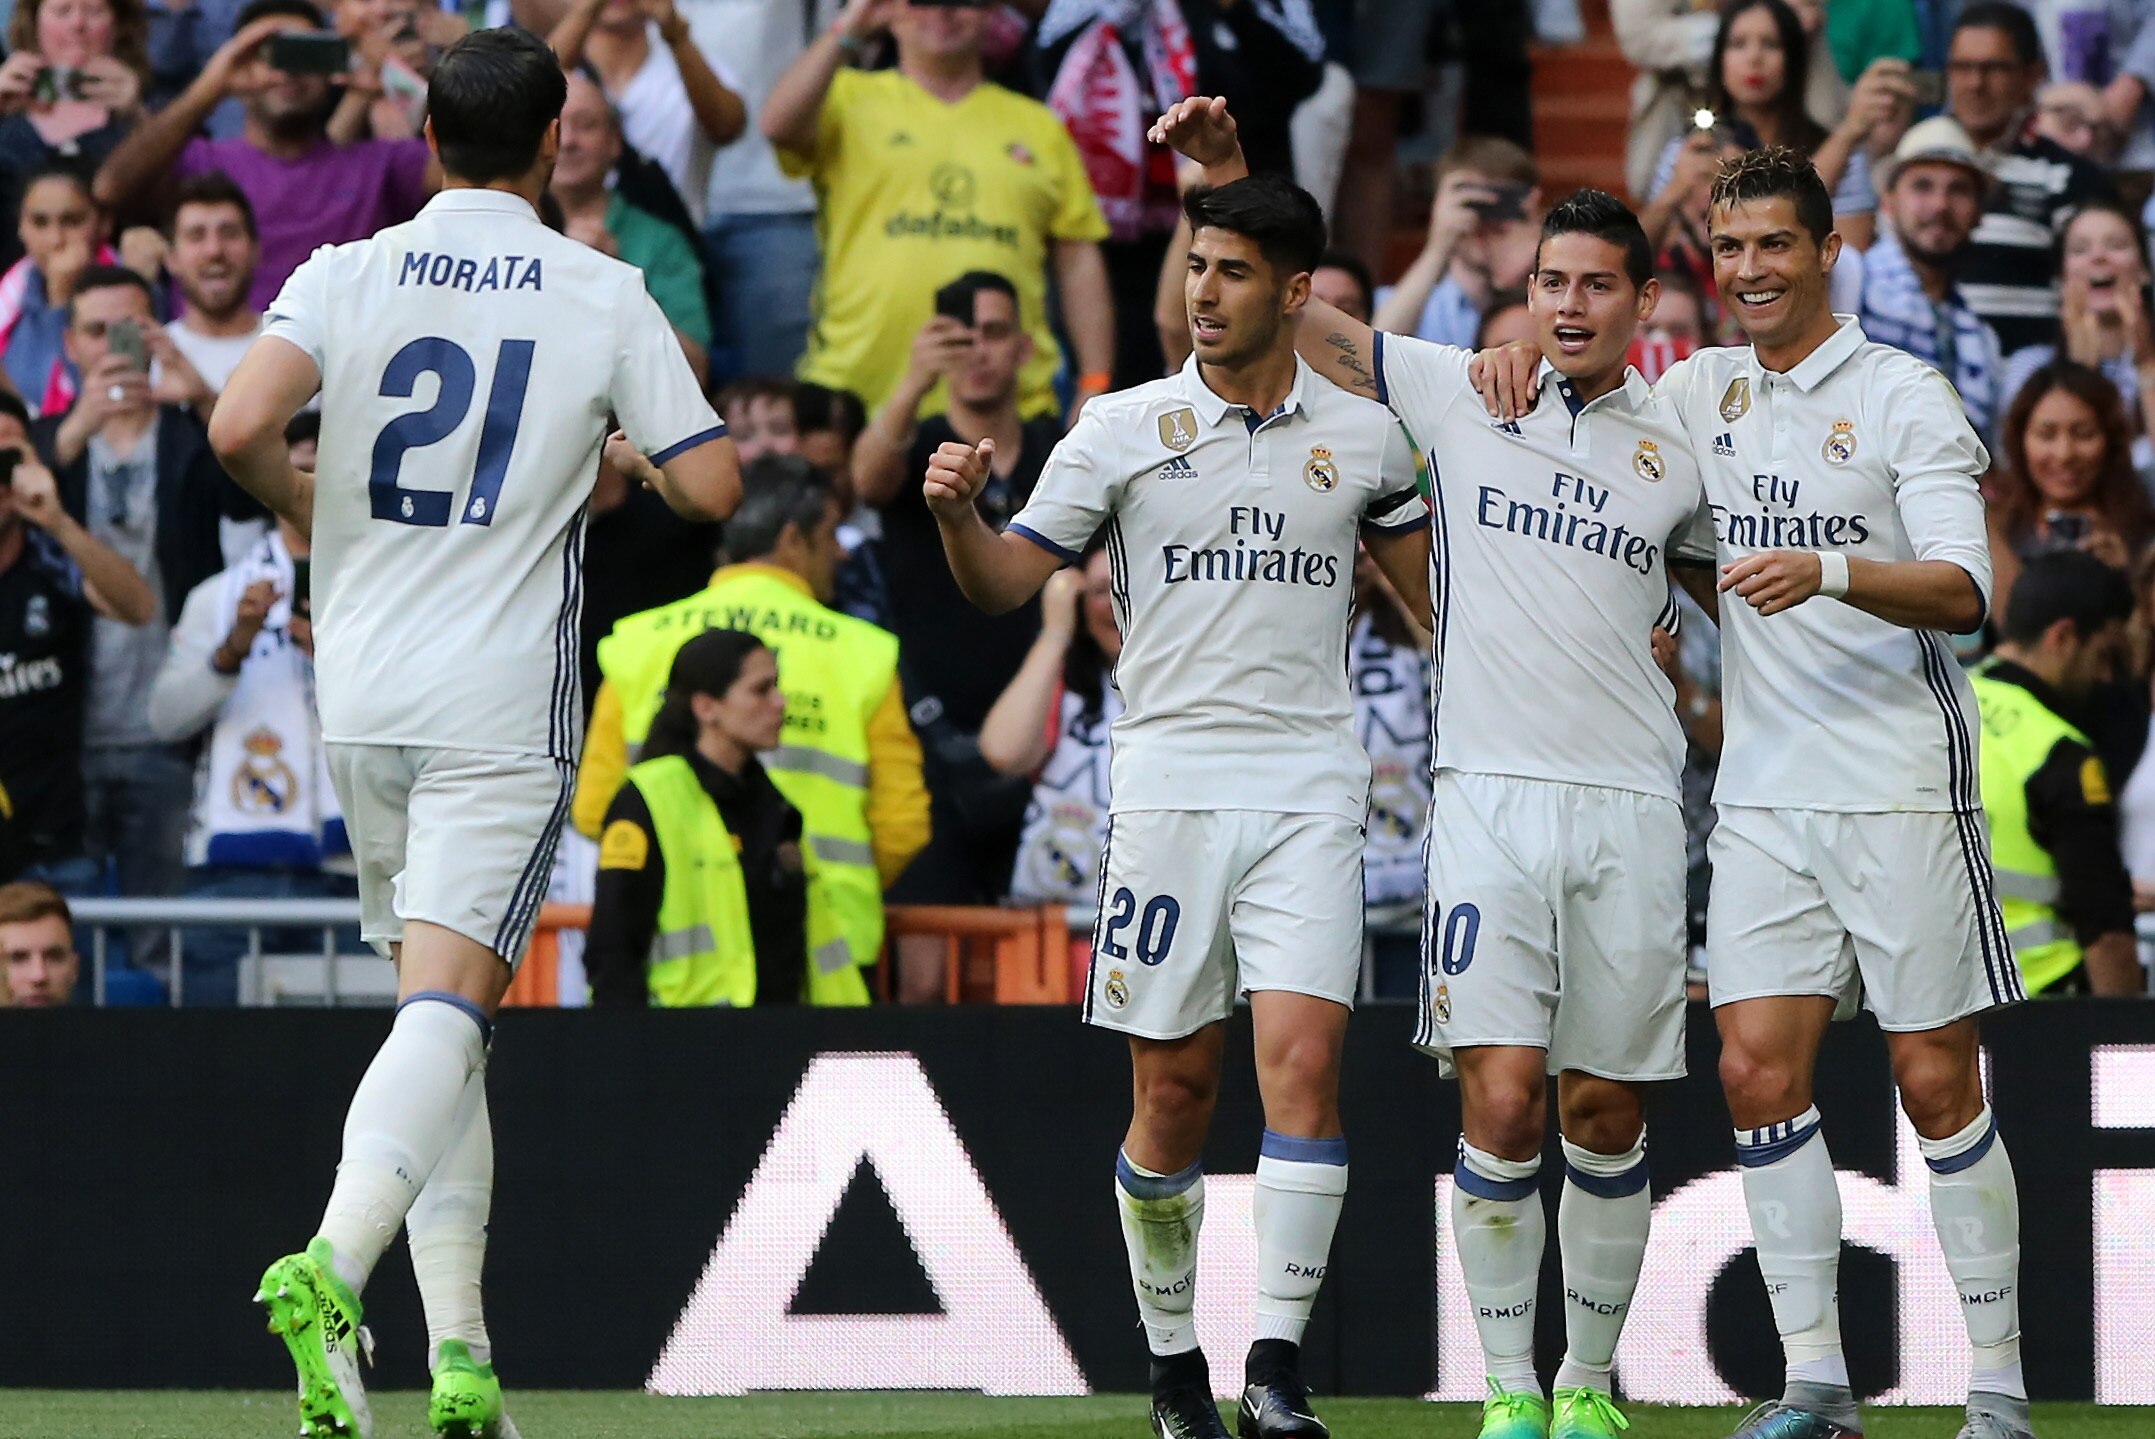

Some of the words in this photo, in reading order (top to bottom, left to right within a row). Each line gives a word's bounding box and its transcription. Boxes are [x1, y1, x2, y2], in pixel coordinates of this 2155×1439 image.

[398, 252, 542, 293] MORATA
[369, 336, 536, 527] 21
[1158, 470, 1198, 480] adidas
[1552, 472, 1609, 513] Fly
[1753, 474, 1799, 508] Fly
[1230, 507, 1285, 541] Fly
[1478, 485, 1658, 575] Emirates
[1709, 503, 1869, 547] Emirates
[1163, 539, 1338, 588] Emirates
[654, 605, 837, 640] STEWARD
[1101, 887, 1180, 966] 20
[1431, 900, 1480, 975] 10
[645, 1048, 2155, 1405] Adi
[319, 1290, 337, 1353] adidas
[1480, 1298, 1533, 1319] RMCF
[1567, 1288, 1627, 1316] RMCF
